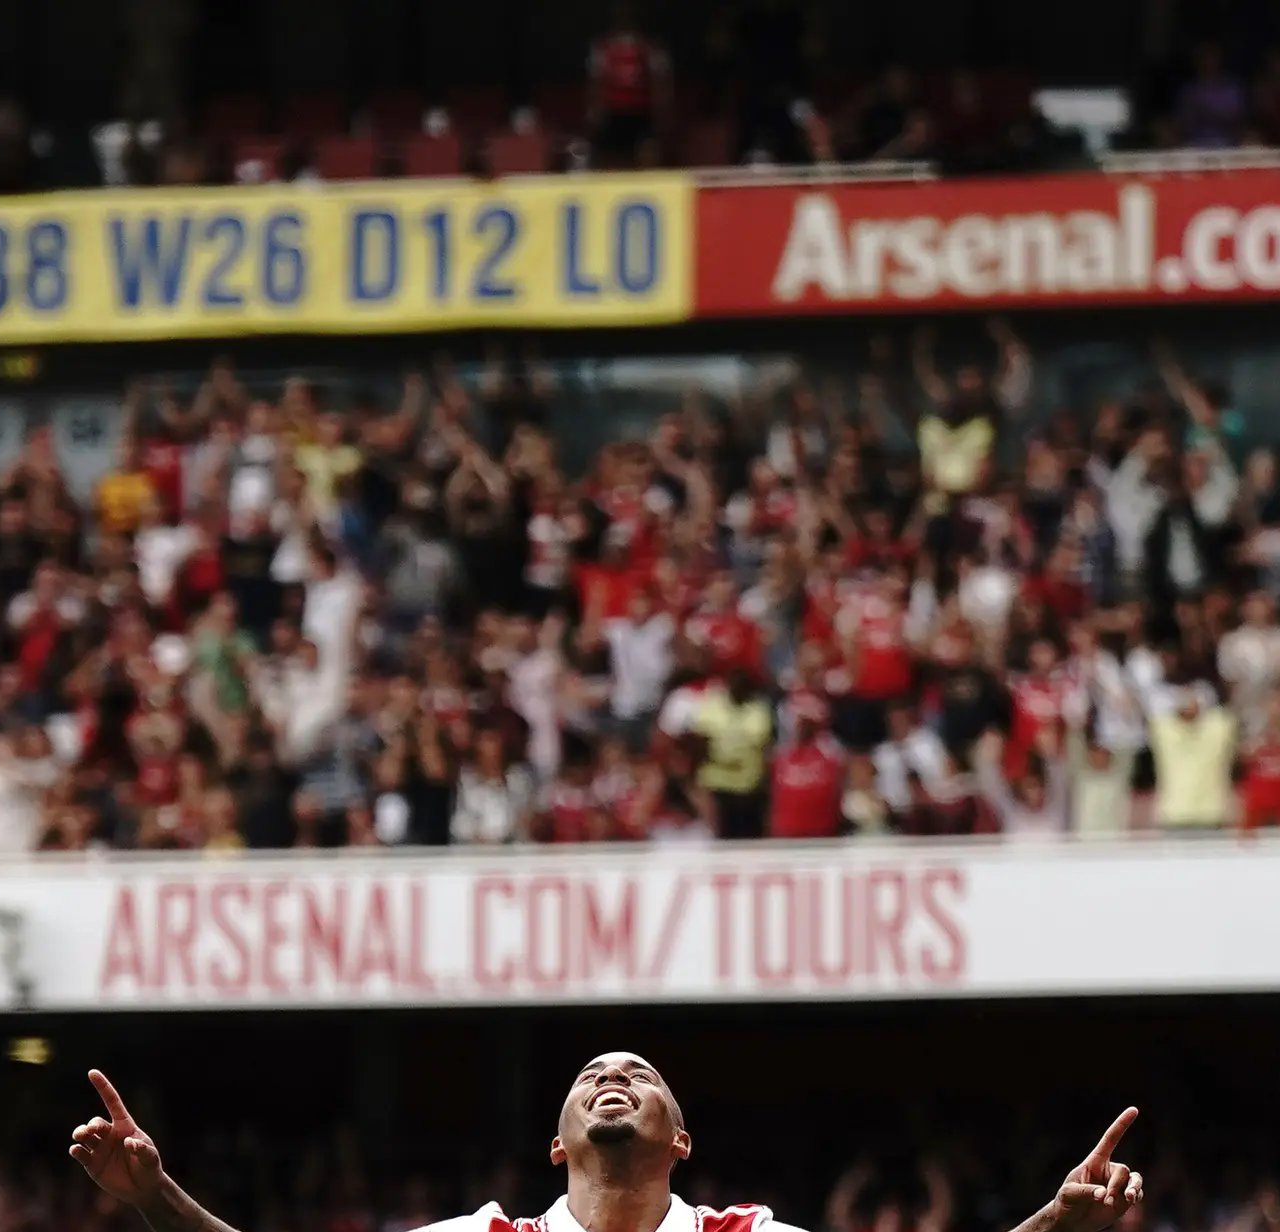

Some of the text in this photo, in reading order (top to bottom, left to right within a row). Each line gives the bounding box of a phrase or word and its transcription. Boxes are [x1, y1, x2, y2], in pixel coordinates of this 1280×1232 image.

[111, 215, 308, 308] W26
[353, 207, 518, 302] D12
[100, 866, 969, 992] ARSENAL.COM/TOURS
